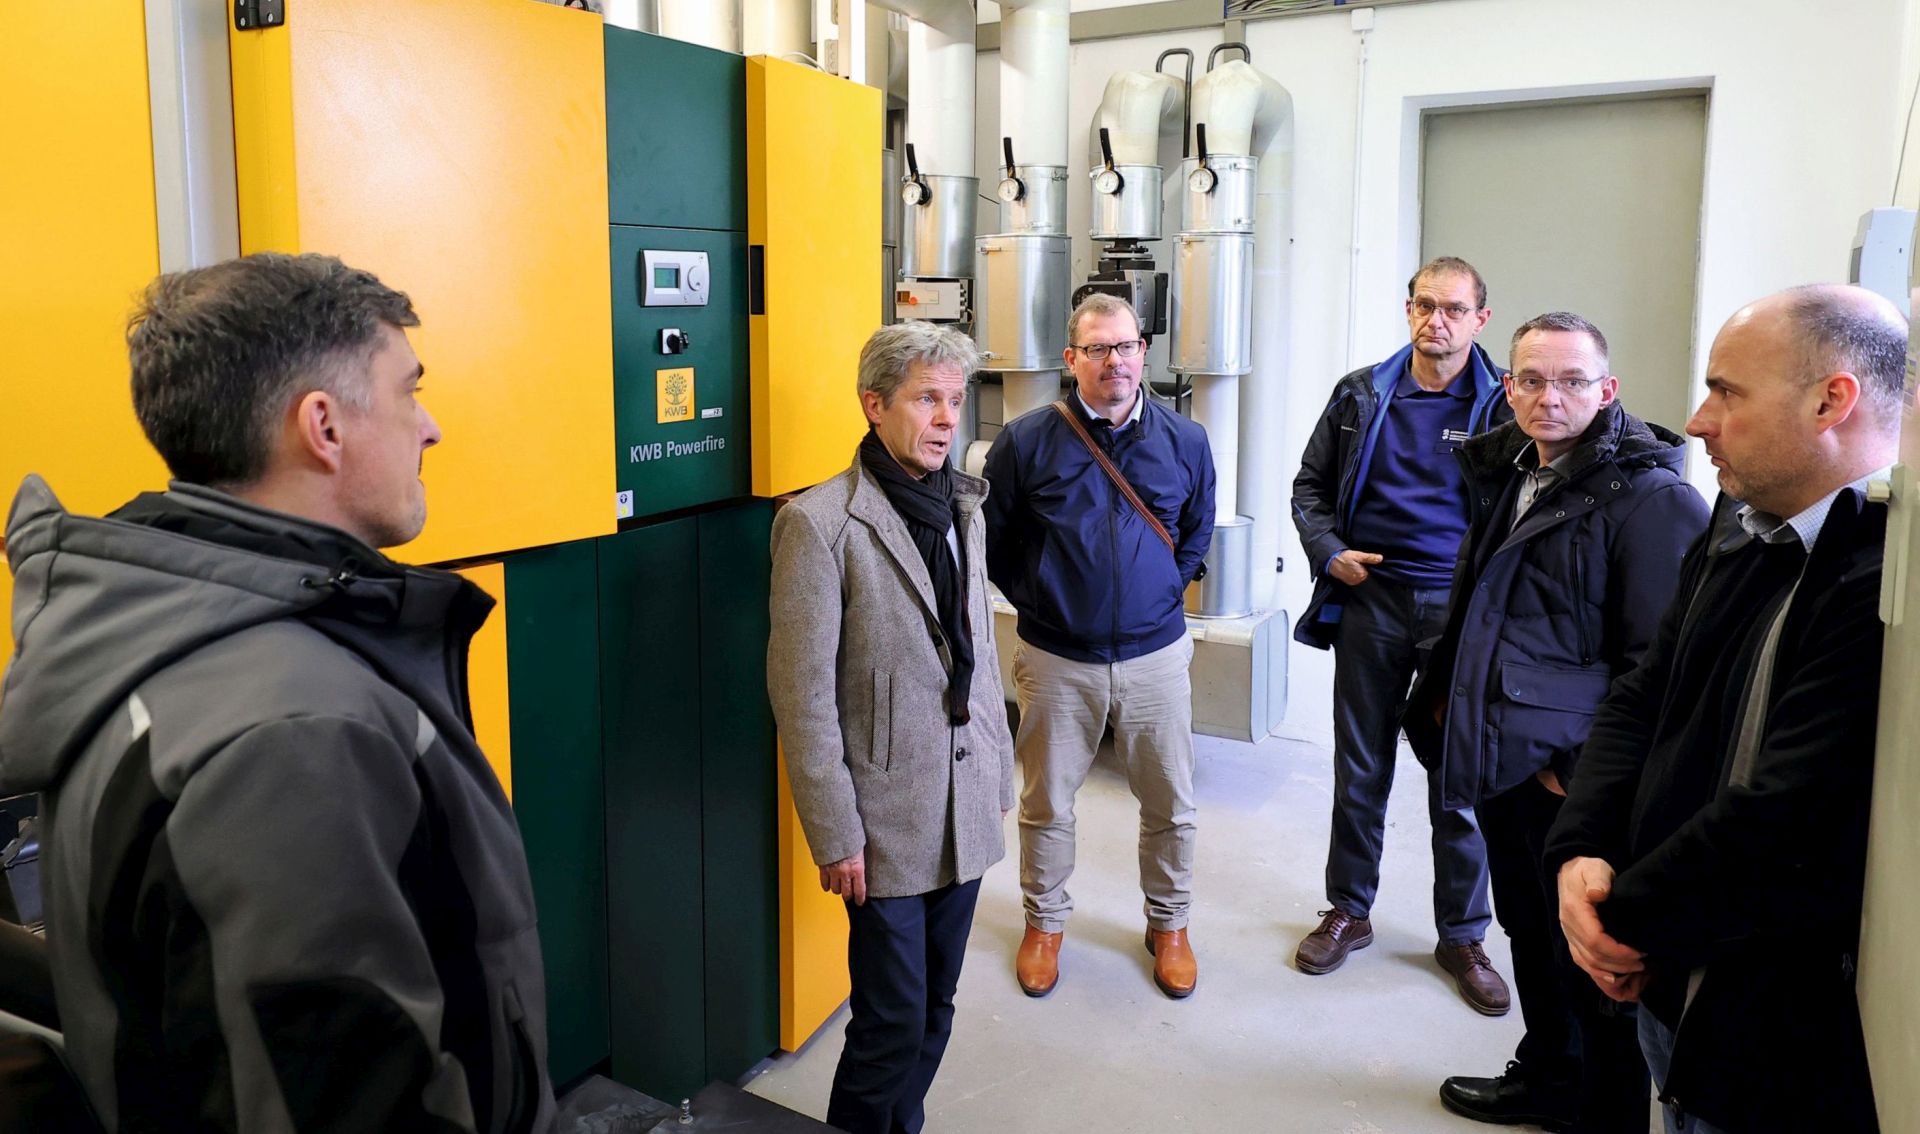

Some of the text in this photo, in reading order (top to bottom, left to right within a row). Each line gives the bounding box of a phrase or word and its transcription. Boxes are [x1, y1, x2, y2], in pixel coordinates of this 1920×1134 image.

[665, 406, 688, 417] KWB
[630, 435, 725, 463] KWB Powerfire
